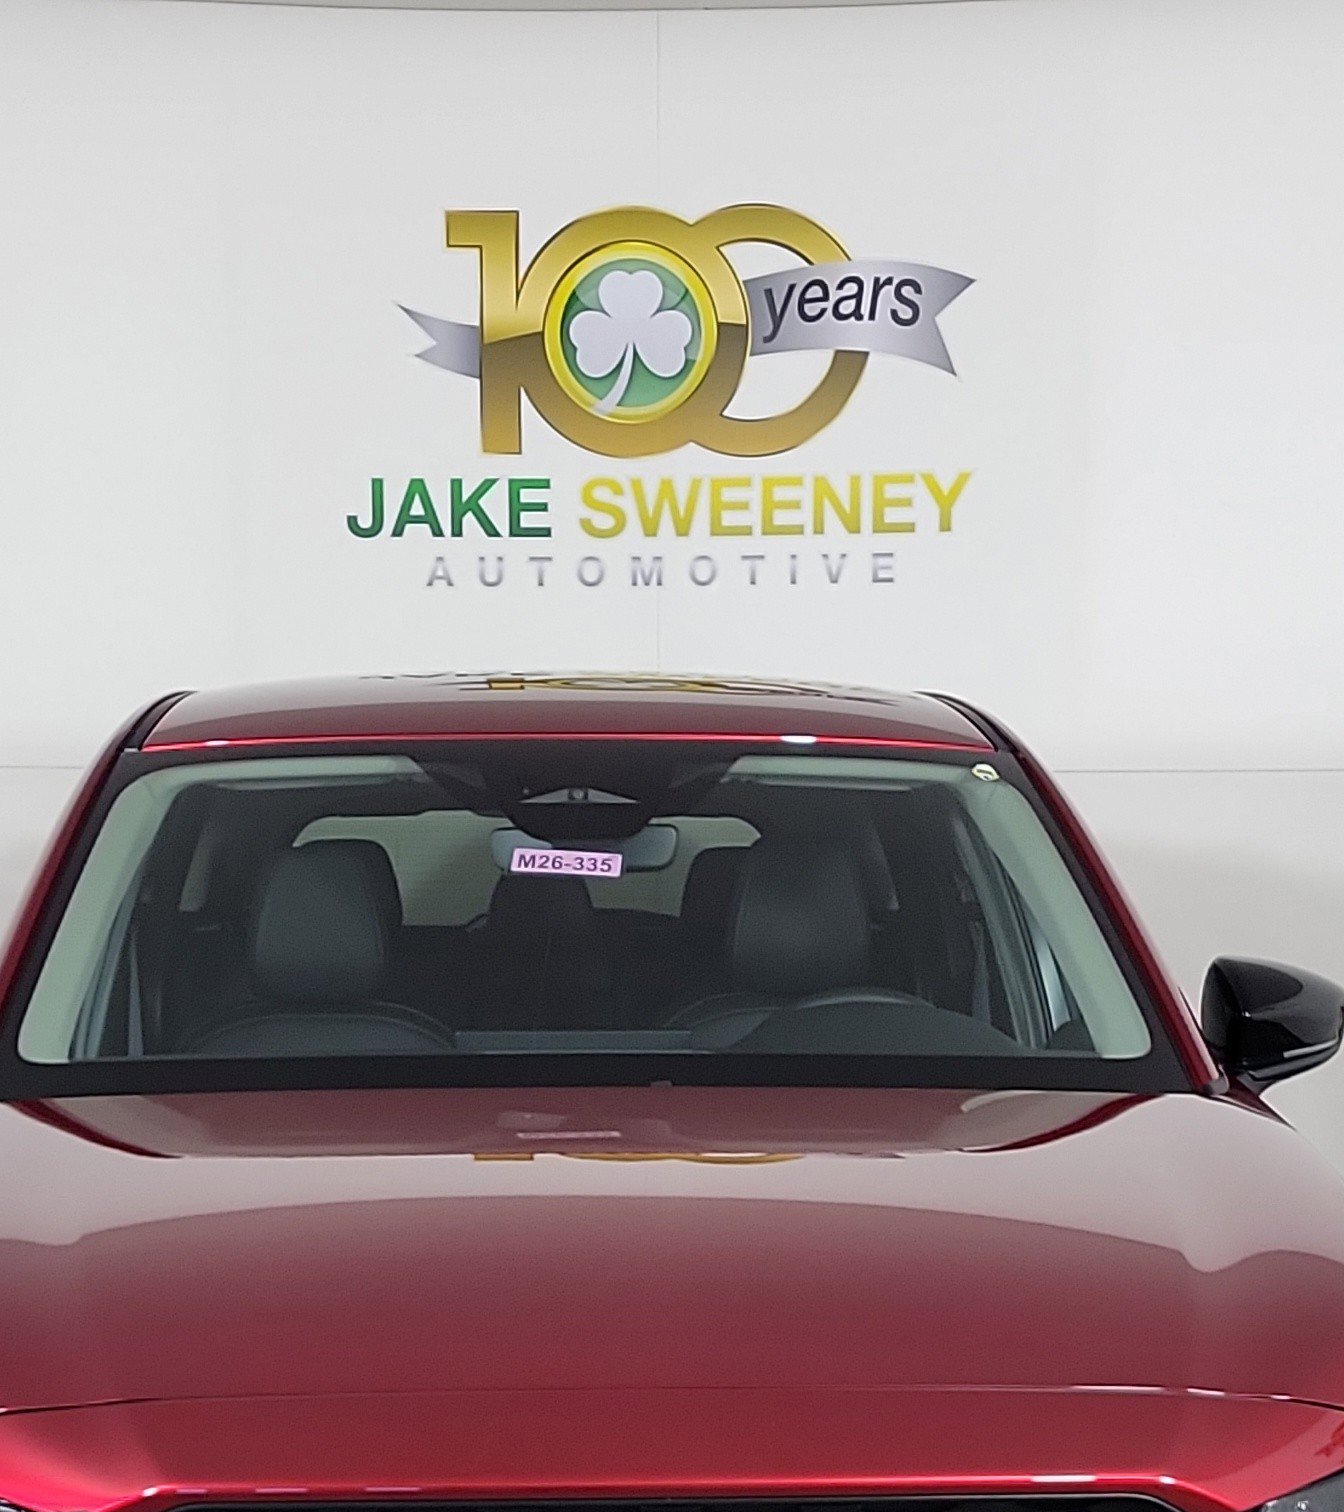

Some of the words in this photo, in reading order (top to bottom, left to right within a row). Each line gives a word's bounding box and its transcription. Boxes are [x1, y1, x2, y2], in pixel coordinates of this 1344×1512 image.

[443, 203, 870, 458] 100
[761, 275, 925, 344] years
[346, 477, 552, 538] JAKE
[578, 471, 973, 538] SWEENEY
[425, 552, 895, 588] AUTOMOTIVE
[517, 853, 612, 873] M26-335
